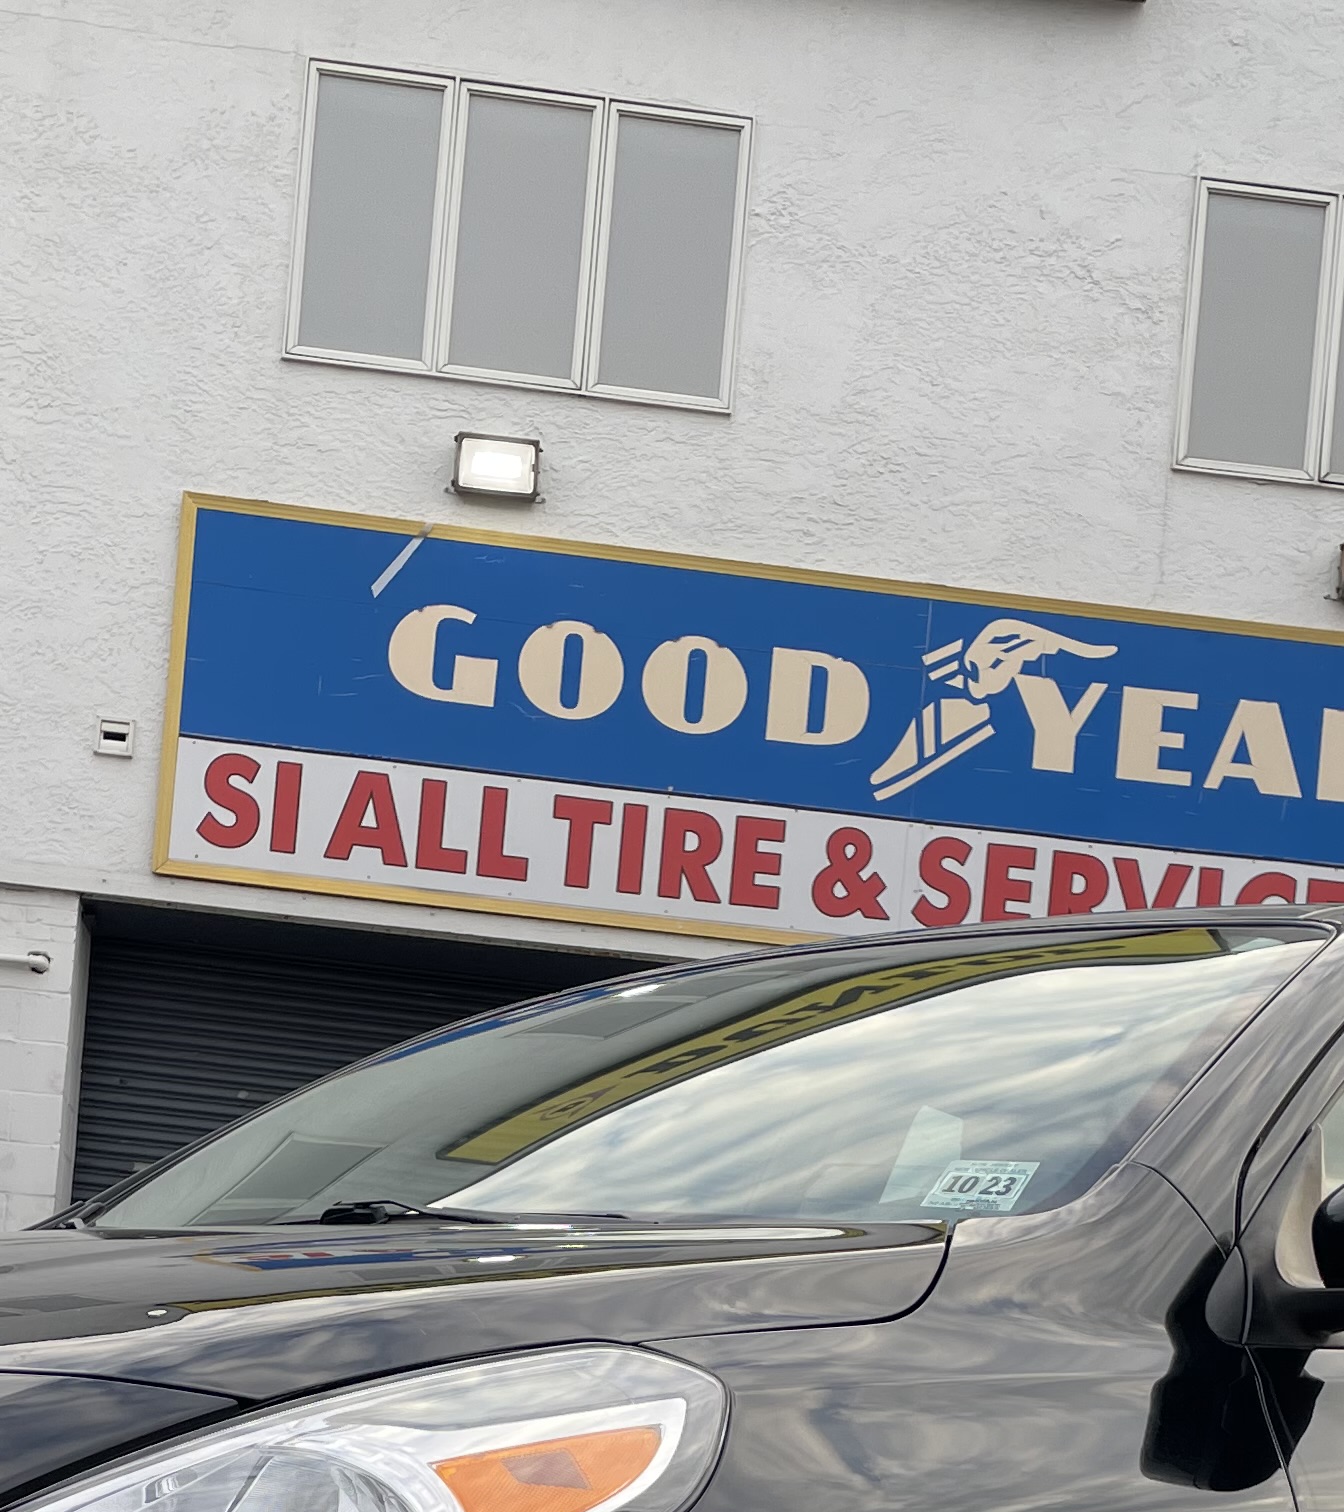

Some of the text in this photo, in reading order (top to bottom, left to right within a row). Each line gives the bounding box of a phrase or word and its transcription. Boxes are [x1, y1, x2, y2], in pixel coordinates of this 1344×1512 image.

[196, 753, 303, 854] SI
[325, 770, 529, 882] ALL
[554, 794, 787, 910] TIRE
[812, 827, 890, 921] &
[942, 1175, 1017, 1196] 10 23
